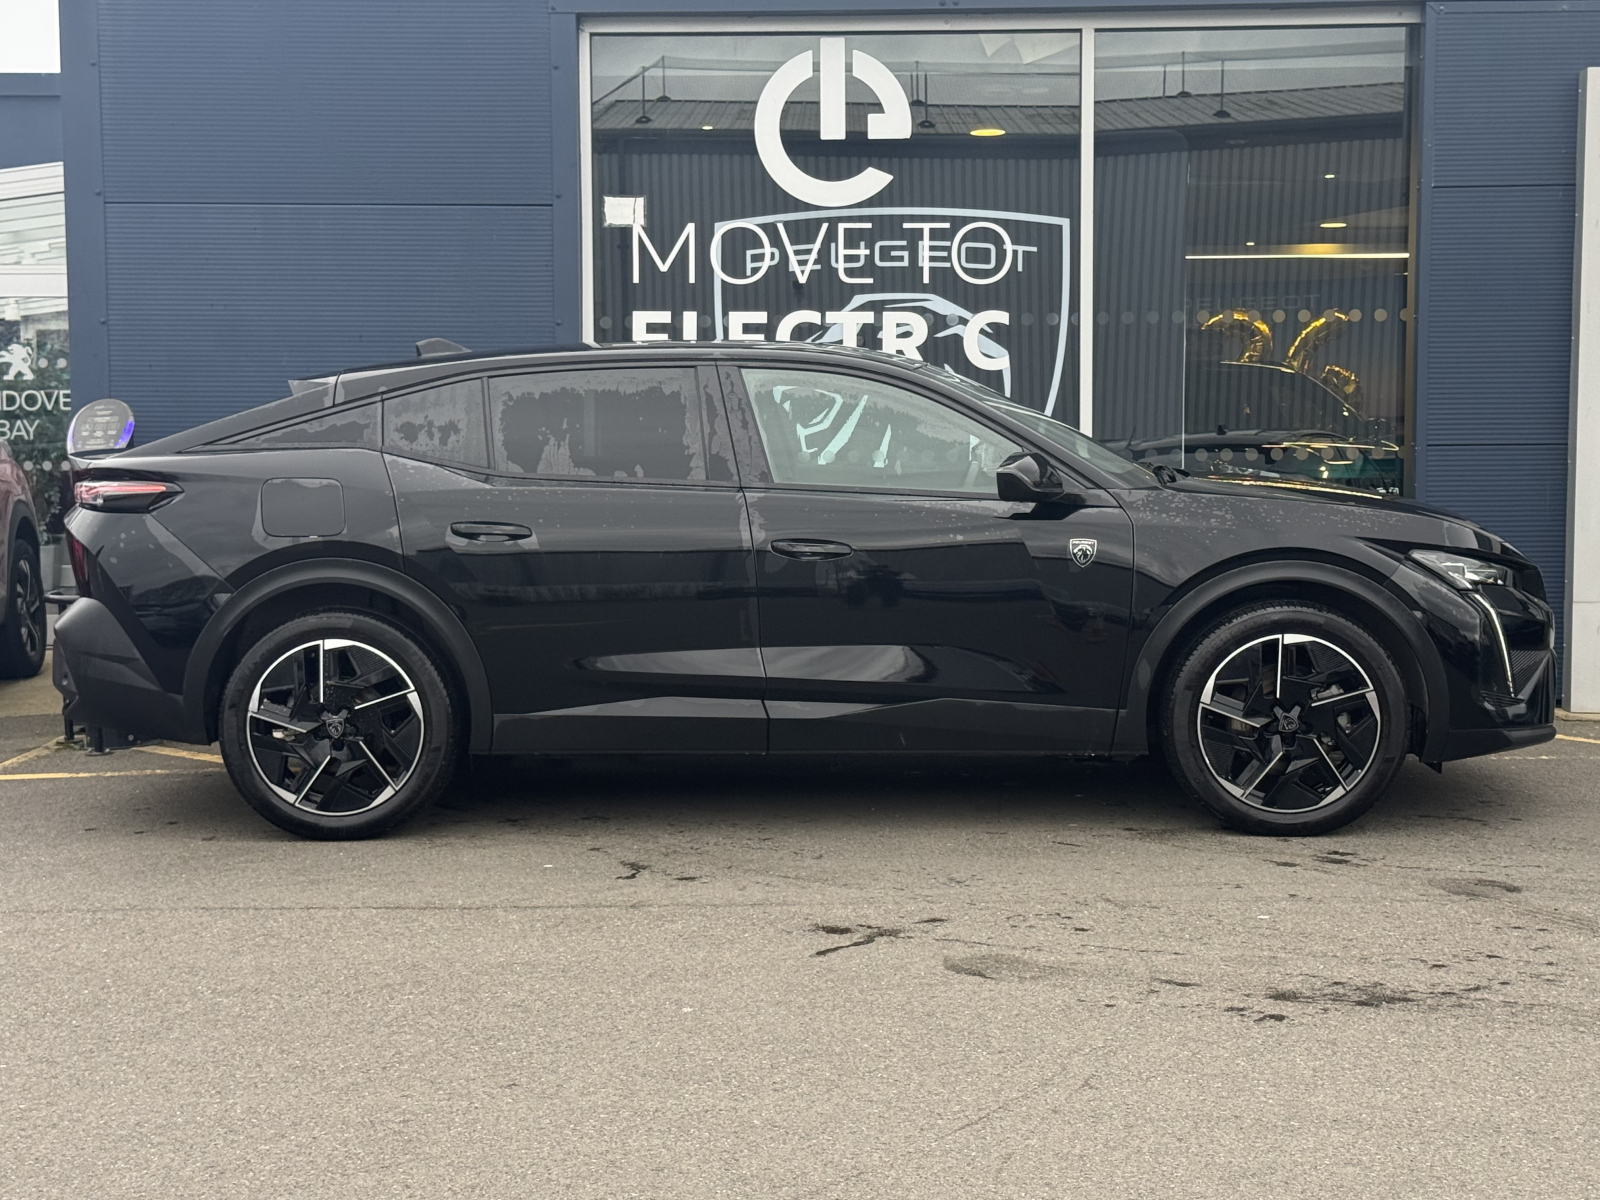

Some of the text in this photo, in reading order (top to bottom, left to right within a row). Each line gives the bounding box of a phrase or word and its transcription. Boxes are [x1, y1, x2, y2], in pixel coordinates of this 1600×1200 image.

[632, 220, 1013, 285] MOVE TO
[745, 240, 1038, 276] PEUGEOT
[0, 389, 71, 411] DOVE
[0, 419, 40, 440] BAY
